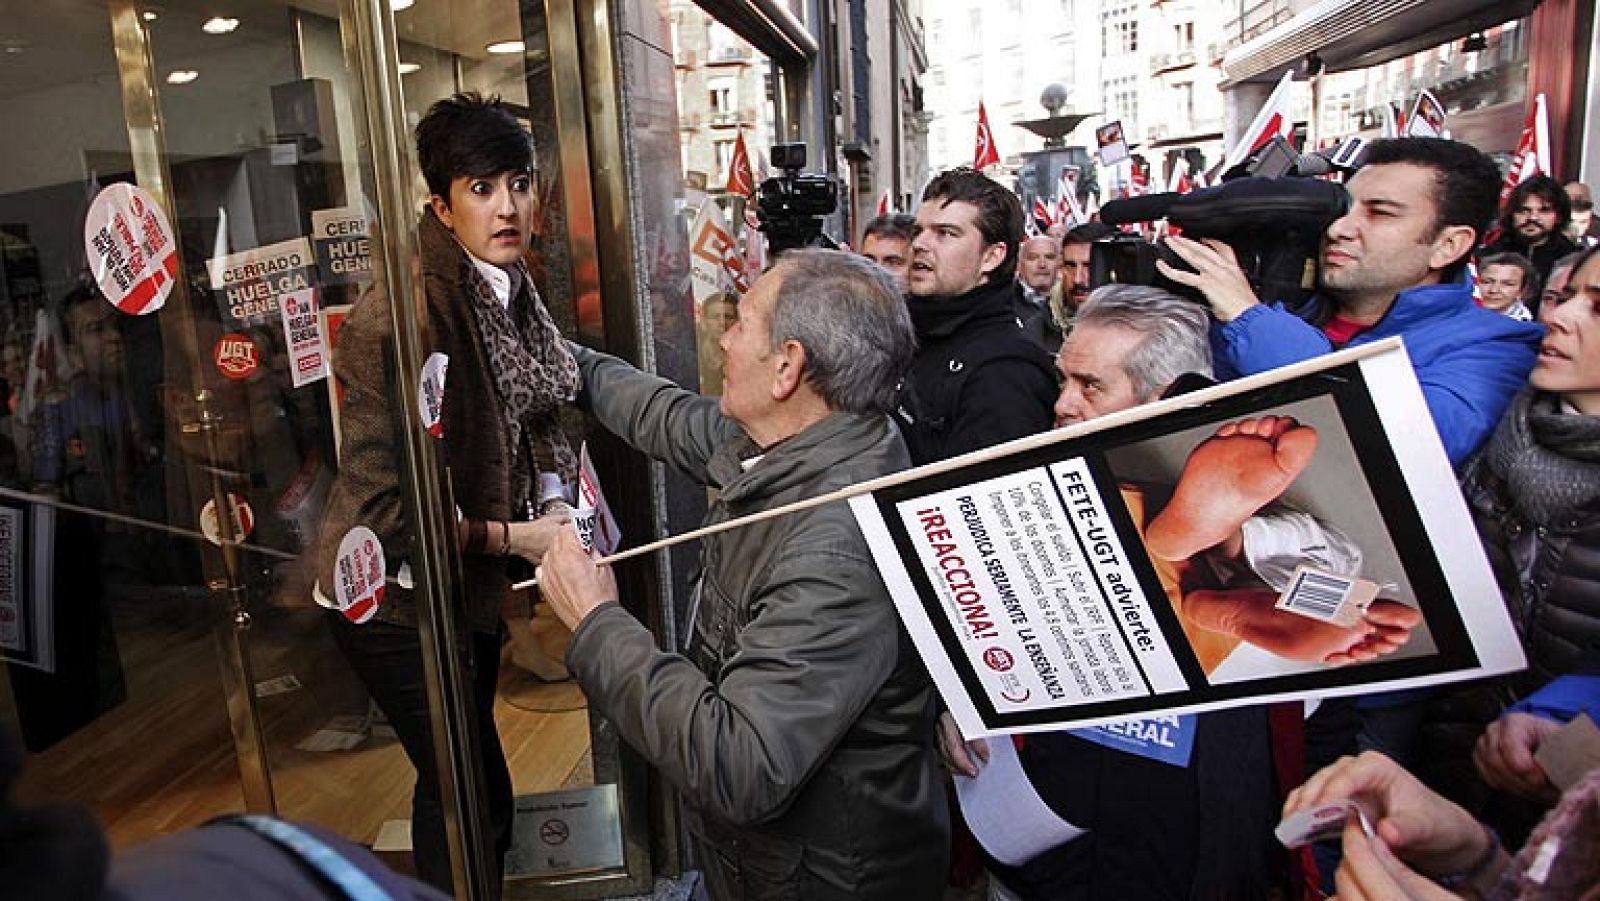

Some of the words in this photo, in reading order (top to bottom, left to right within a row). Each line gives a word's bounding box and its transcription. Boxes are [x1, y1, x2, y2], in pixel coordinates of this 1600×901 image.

[223, 254, 301, 282] CERRADO
[226, 273, 309, 306] HUELGA
[231, 297, 281, 319] GENE
[219, 341, 254, 359] UGT
[956, 496, 996, 557] PERJUDICA
[1018, 511, 1032, 522] de
[1025, 523, 1038, 538] los
[916, 506, 999, 639] ¡REACCIONA!
[1027, 481, 1053, 520] Congelar
[1050, 534, 1073, 562] sueldo
[1097, 633, 1121, 664] Reponer
[1031, 540, 1057, 578] docentes
[1062, 471, 1119, 565] FETE-UGT
[1106, 573, 1155, 651] advierte:
[983, 558, 1028, 624] SERIAMENTE
[1055, 587, 1080, 625] Aumentar
[1017, 628, 1036, 643] LA
[1025, 643, 1065, 700] ENSEÑANZA
